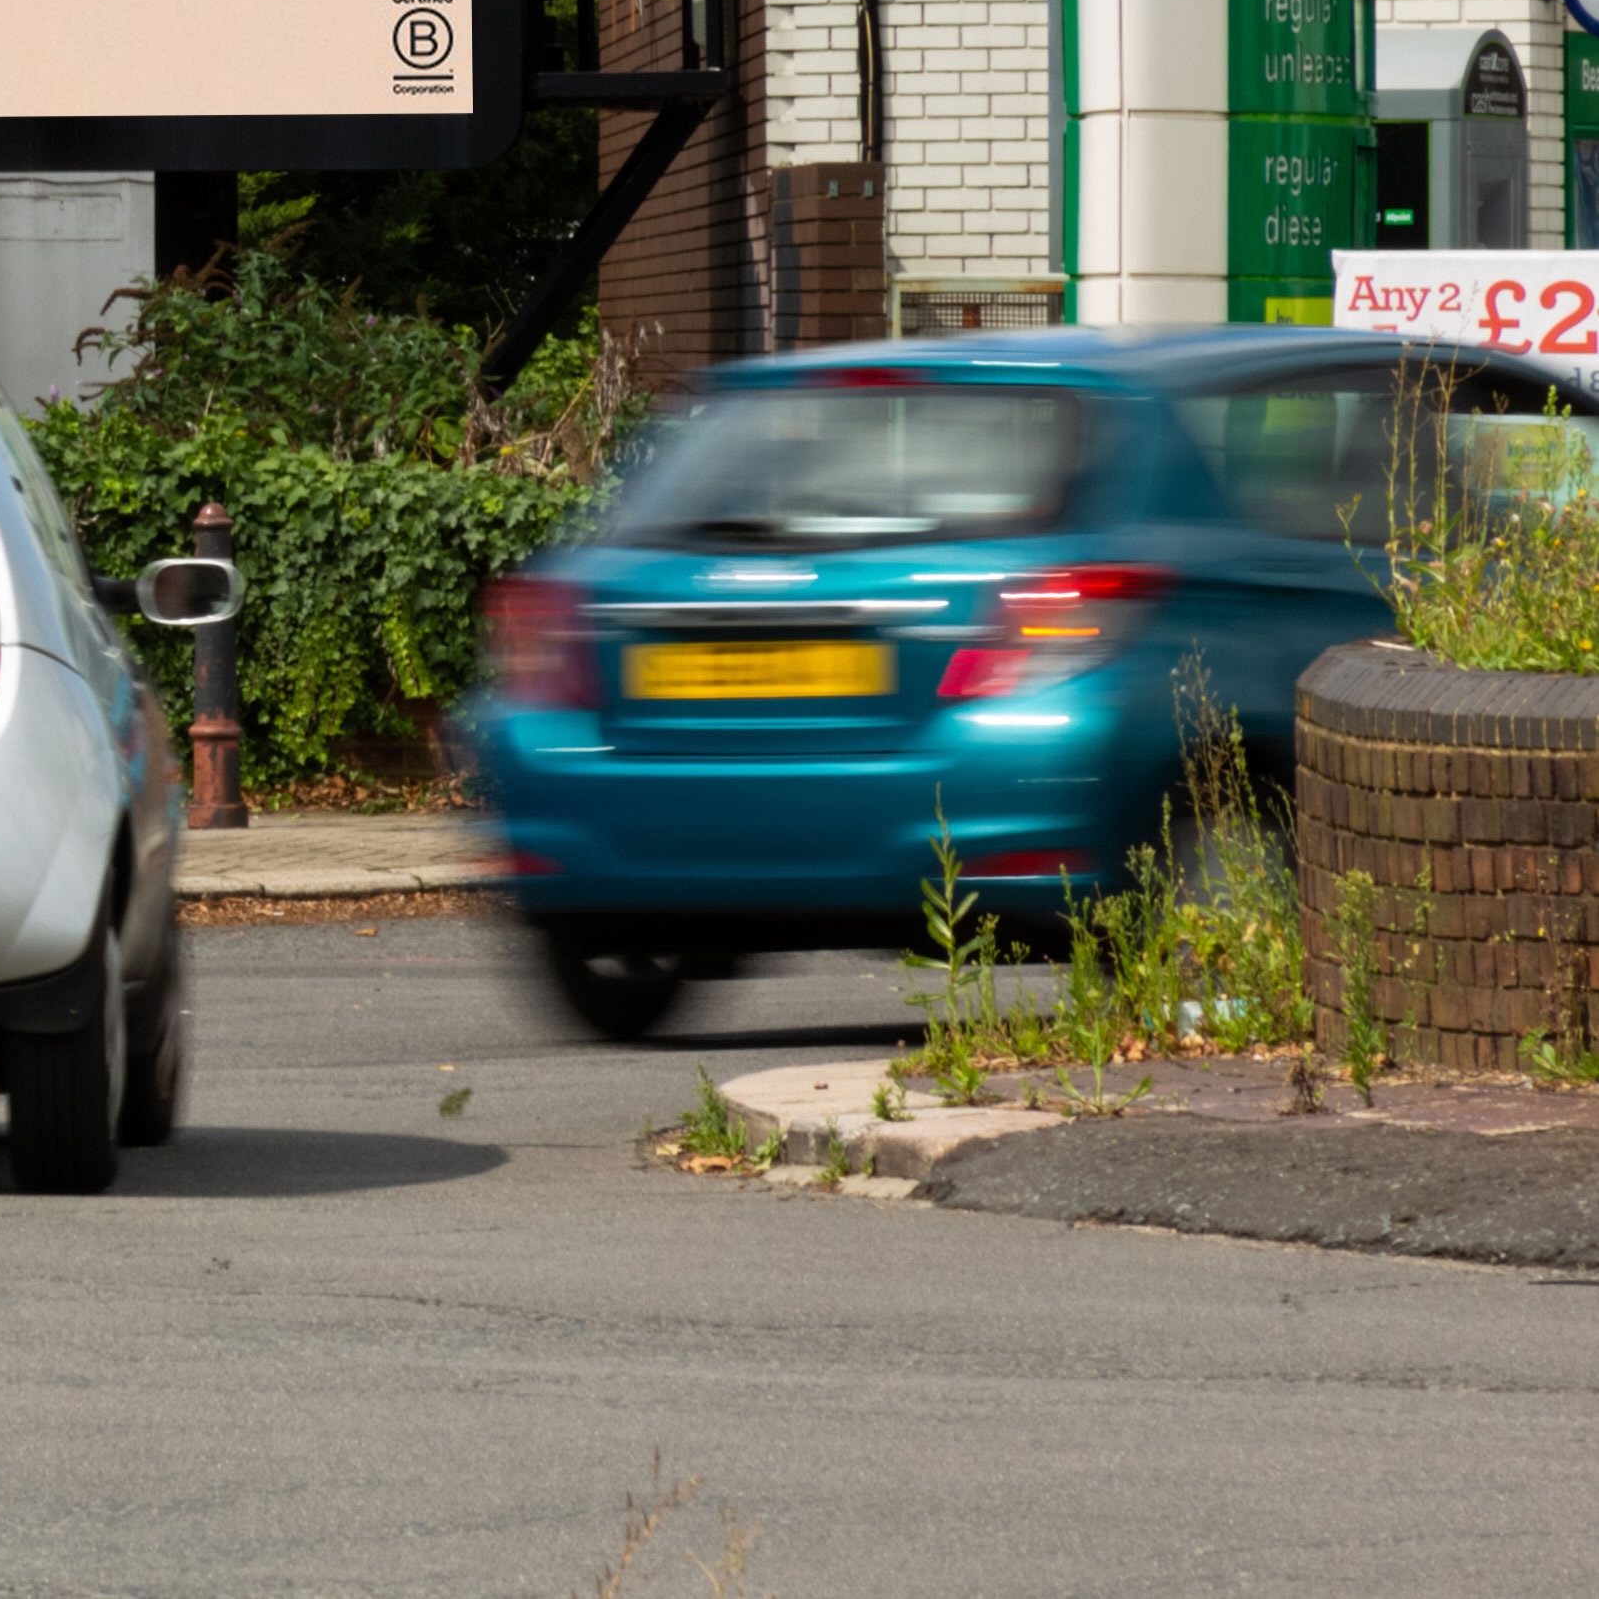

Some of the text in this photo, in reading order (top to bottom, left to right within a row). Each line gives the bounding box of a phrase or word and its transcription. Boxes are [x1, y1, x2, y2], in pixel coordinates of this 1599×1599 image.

[409, 20, 439, 57] B
[392, 83, 456, 97] Corporation
[1348, 275, 1462, 321] Any 2
[1477, 280, 1599, 355] £2
